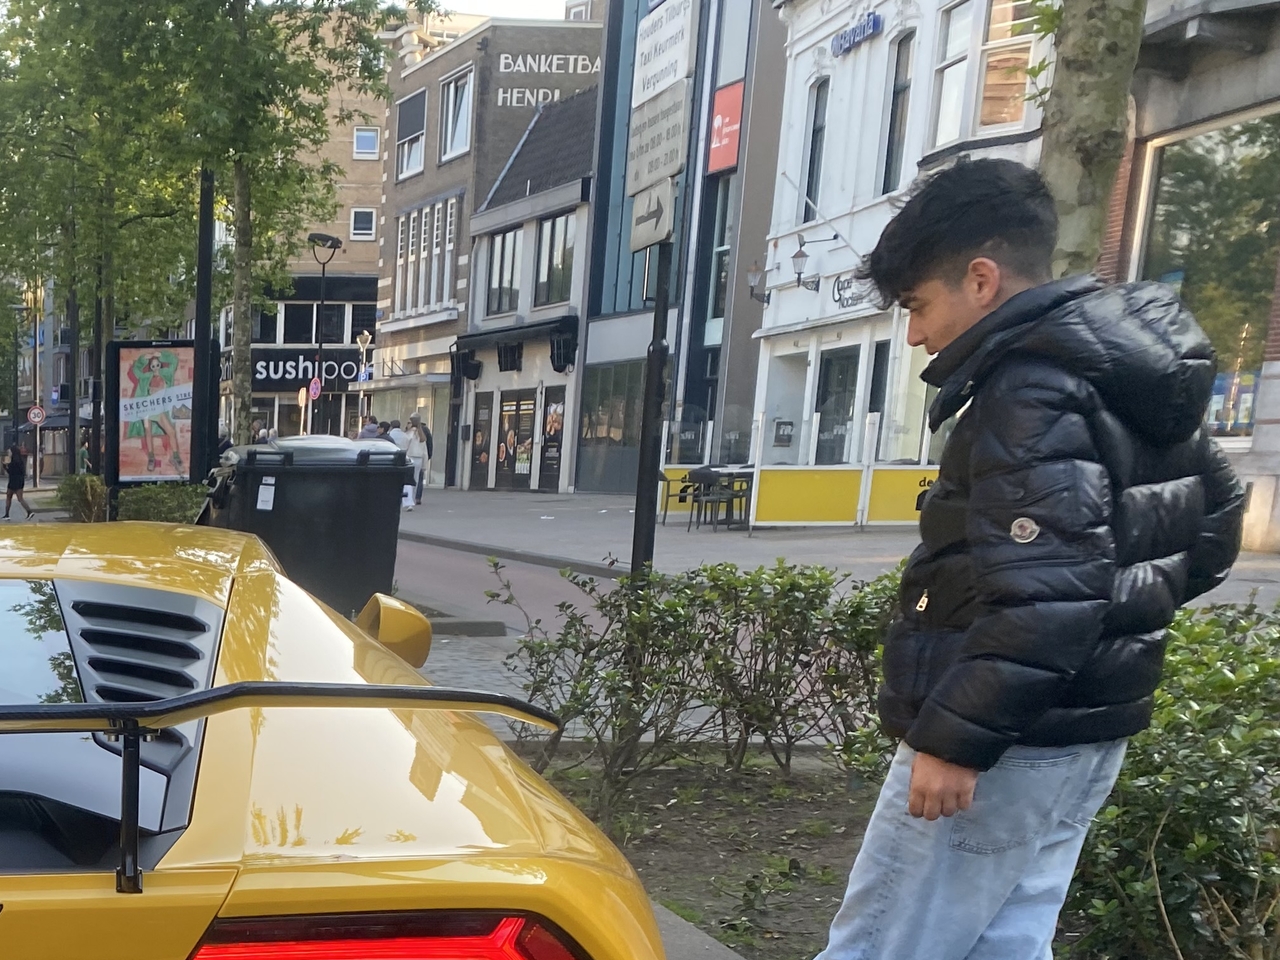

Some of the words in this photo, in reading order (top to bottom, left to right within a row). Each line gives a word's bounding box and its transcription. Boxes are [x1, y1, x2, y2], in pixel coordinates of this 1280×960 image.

[642, 59, 678, 92] Vergunning
[123, 395, 173, 412] SKECHERS
[32, 411, 41, 419] 30
